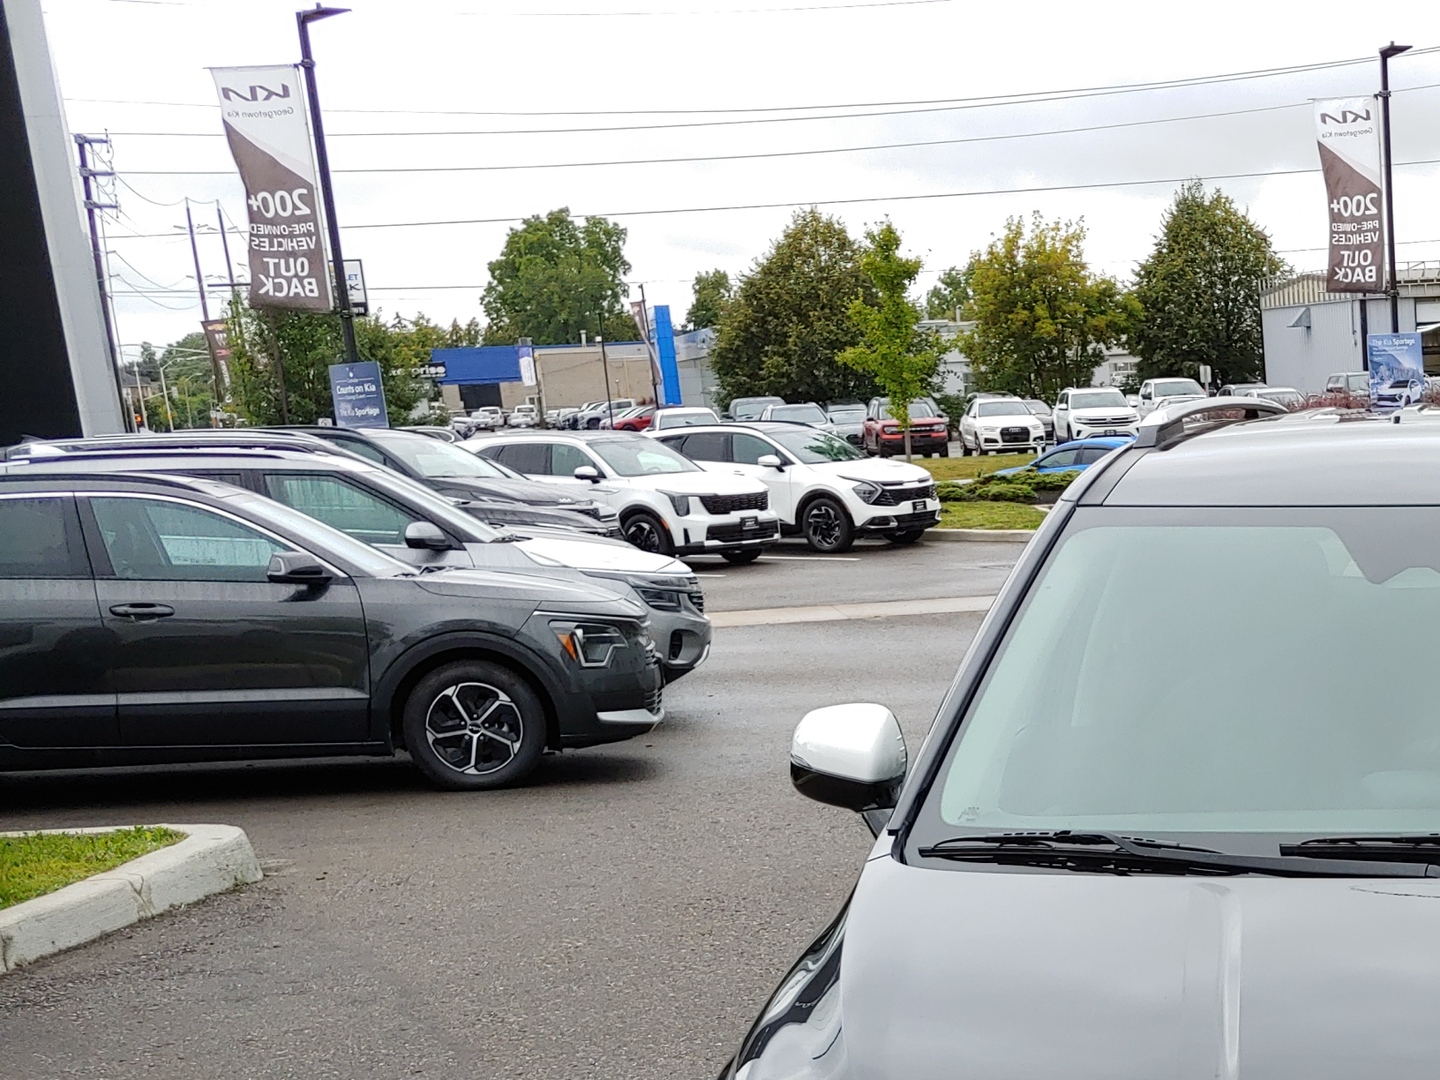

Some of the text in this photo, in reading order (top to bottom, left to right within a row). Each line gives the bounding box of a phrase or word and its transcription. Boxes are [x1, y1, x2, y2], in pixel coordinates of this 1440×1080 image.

[1392, 338, 1415, 346] Sportage
[336, 383, 376, 394] Counts on Kia
[355, 407, 380, 418] Sportage
